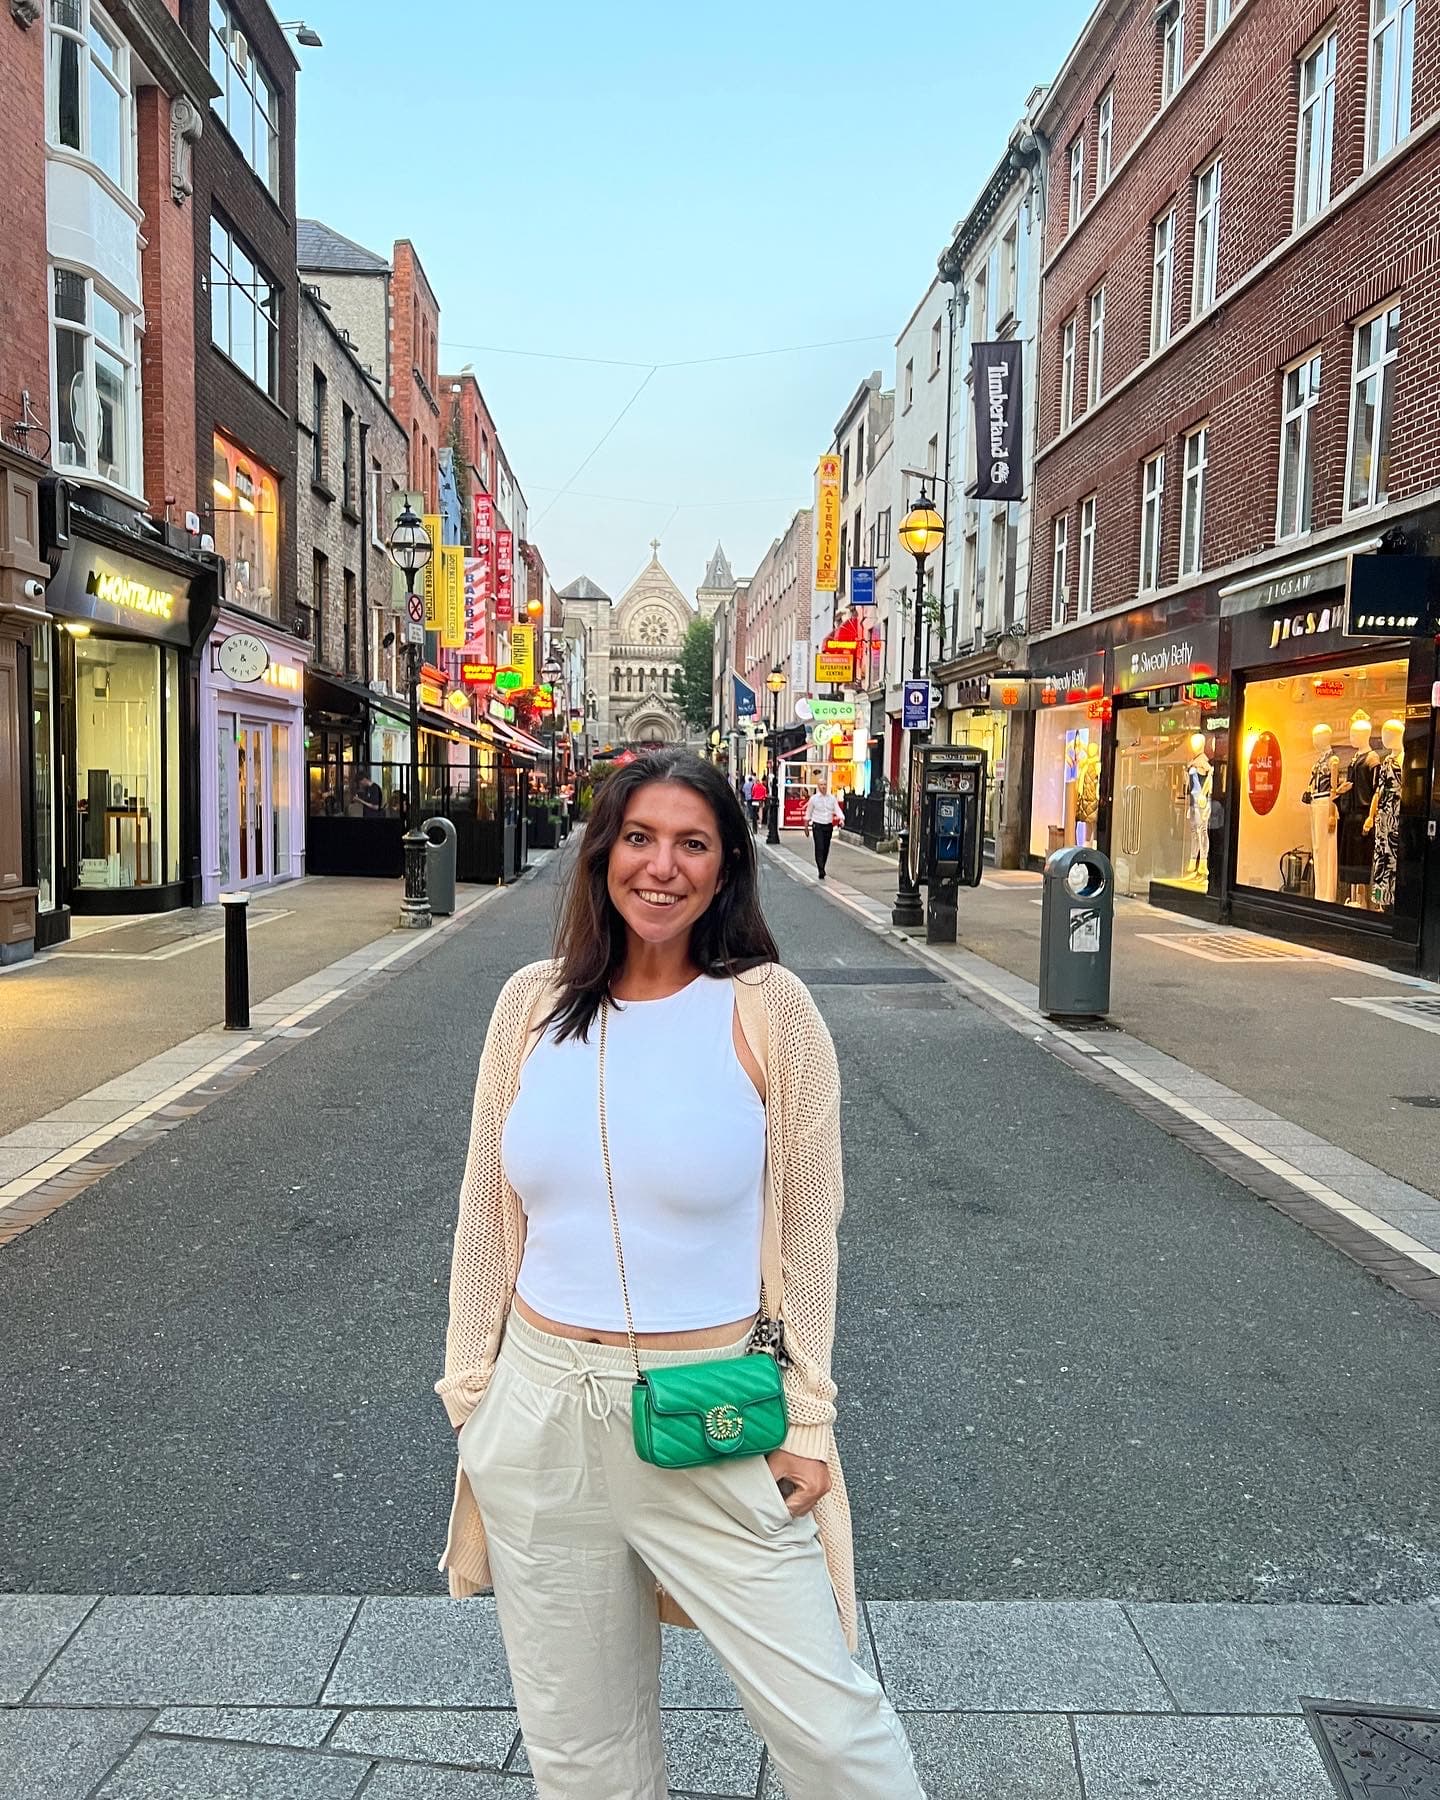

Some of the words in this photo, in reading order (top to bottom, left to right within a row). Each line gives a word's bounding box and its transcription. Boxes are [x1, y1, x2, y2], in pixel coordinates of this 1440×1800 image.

[988, 361, 1009, 458] Timberland
[824, 490, 833, 570] ALTERATION
[95, 572, 172, 619] MONTBLANC
[1267, 574, 1312, 604] JIGSAW
[425, 590, 433, 621] KITCHEN
[465, 574, 475, 641] BARBER
[1269, 604, 1345, 649] JIGSAW
[1357, 615, 1418, 628] JIGSAW
[227, 640, 258, 653] ASTRID
[240, 654, 247, 662] &
[513, 633, 529, 665] GOTHAM
[1141, 648, 1170, 673] Sweaty
[1171, 642, 1193, 667] Betty
[230, 665, 257, 677] MIYU
[1051, 673, 1071, 691] Sweaty
[1071, 667, 1087, 689] Betty
[822, 706, 837, 716] cig
[1256, 756, 1273, 768] SALE
